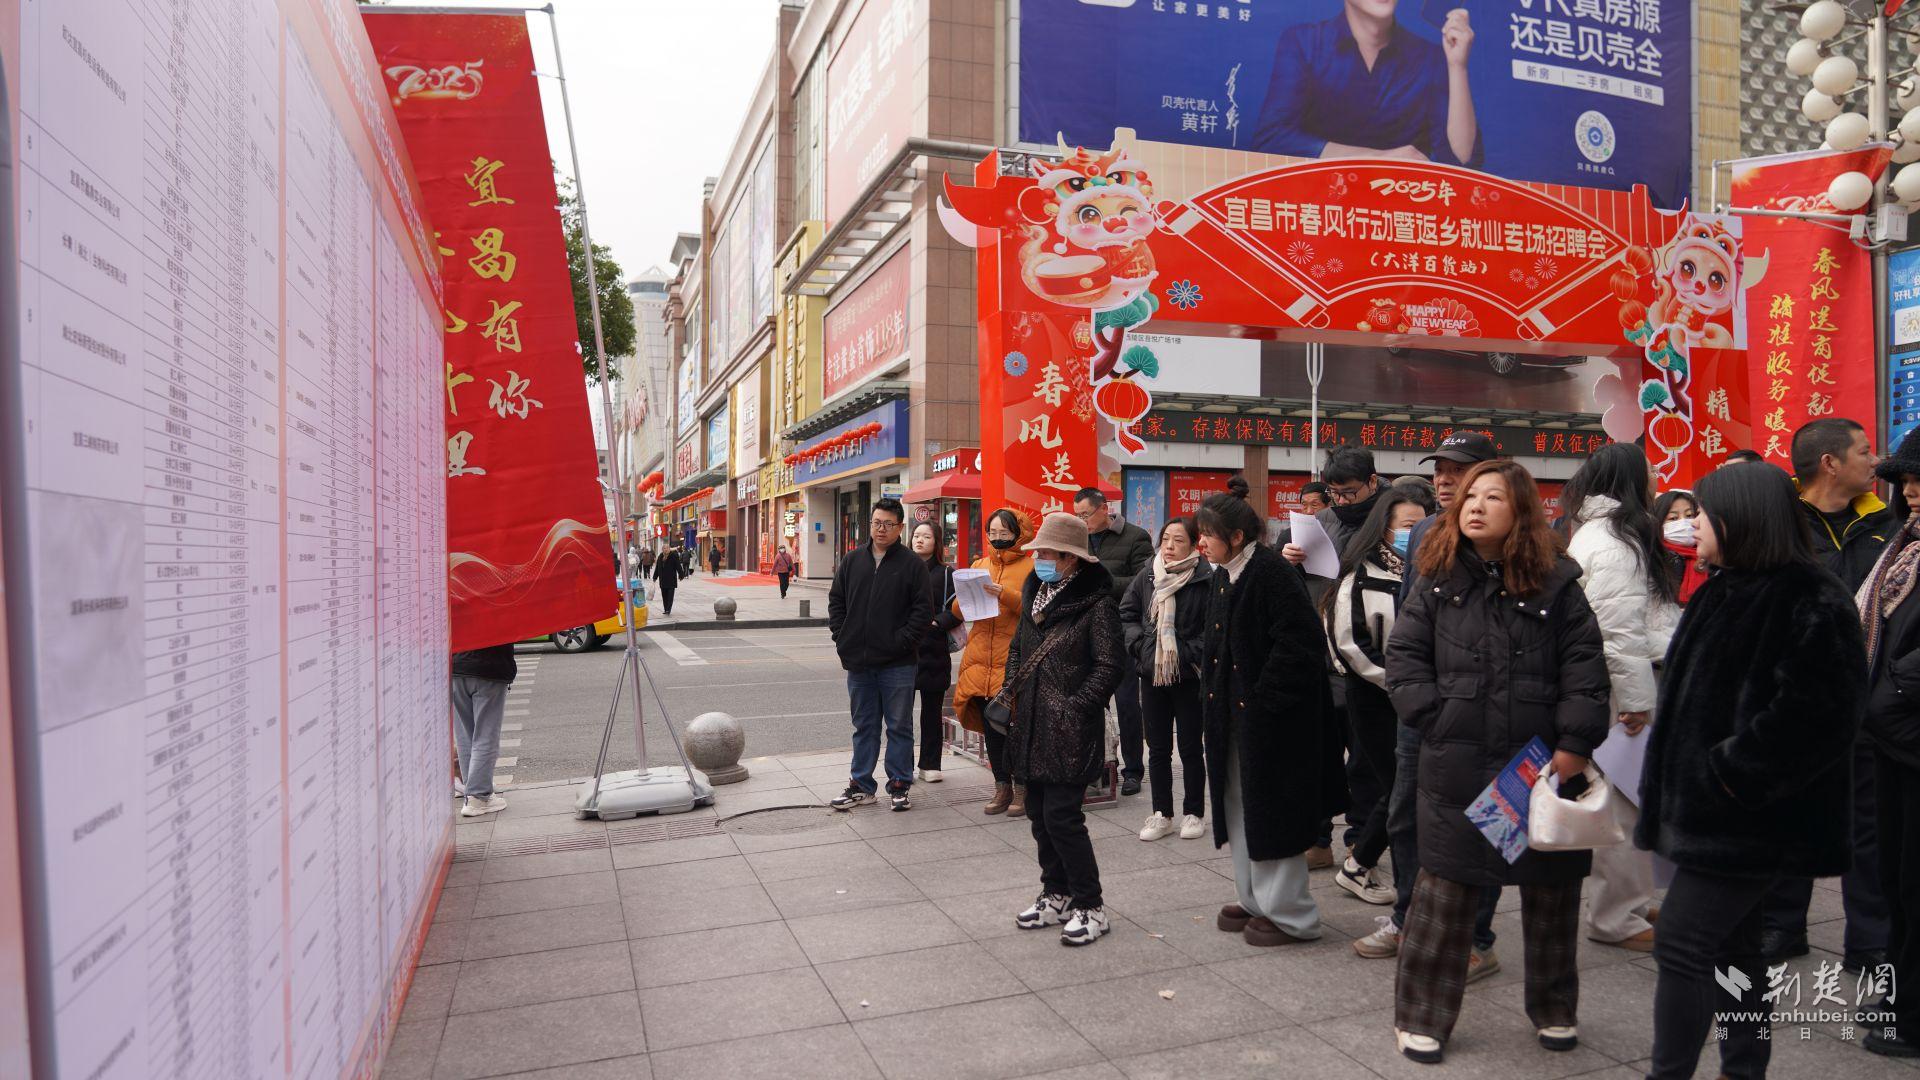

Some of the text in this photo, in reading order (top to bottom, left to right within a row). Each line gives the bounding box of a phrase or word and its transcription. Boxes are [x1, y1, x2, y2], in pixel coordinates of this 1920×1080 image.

[1153, 0, 1251, 22] 让家更美好
[1510, 12, 1663, 77] 还是贝壳全
[385, 59, 484, 101] 2025
[1526, 65, 1550, 80] 新房
[1576, 74, 1610, 91] 二手房
[1162, 95, 1219, 113] 贝壳代言人
[1181, 112, 1218, 133] 黄轩
[1369, 178, 1457, 207] 2025年
[1224, 197, 1608, 261] 宜昌市春风行动暨返乡就业专场招聘会
[464, 156, 544, 420] 宜昌有你
[1405, 304, 1446, 318] HAPPY
[1075, 329, 1090, 345] 福
